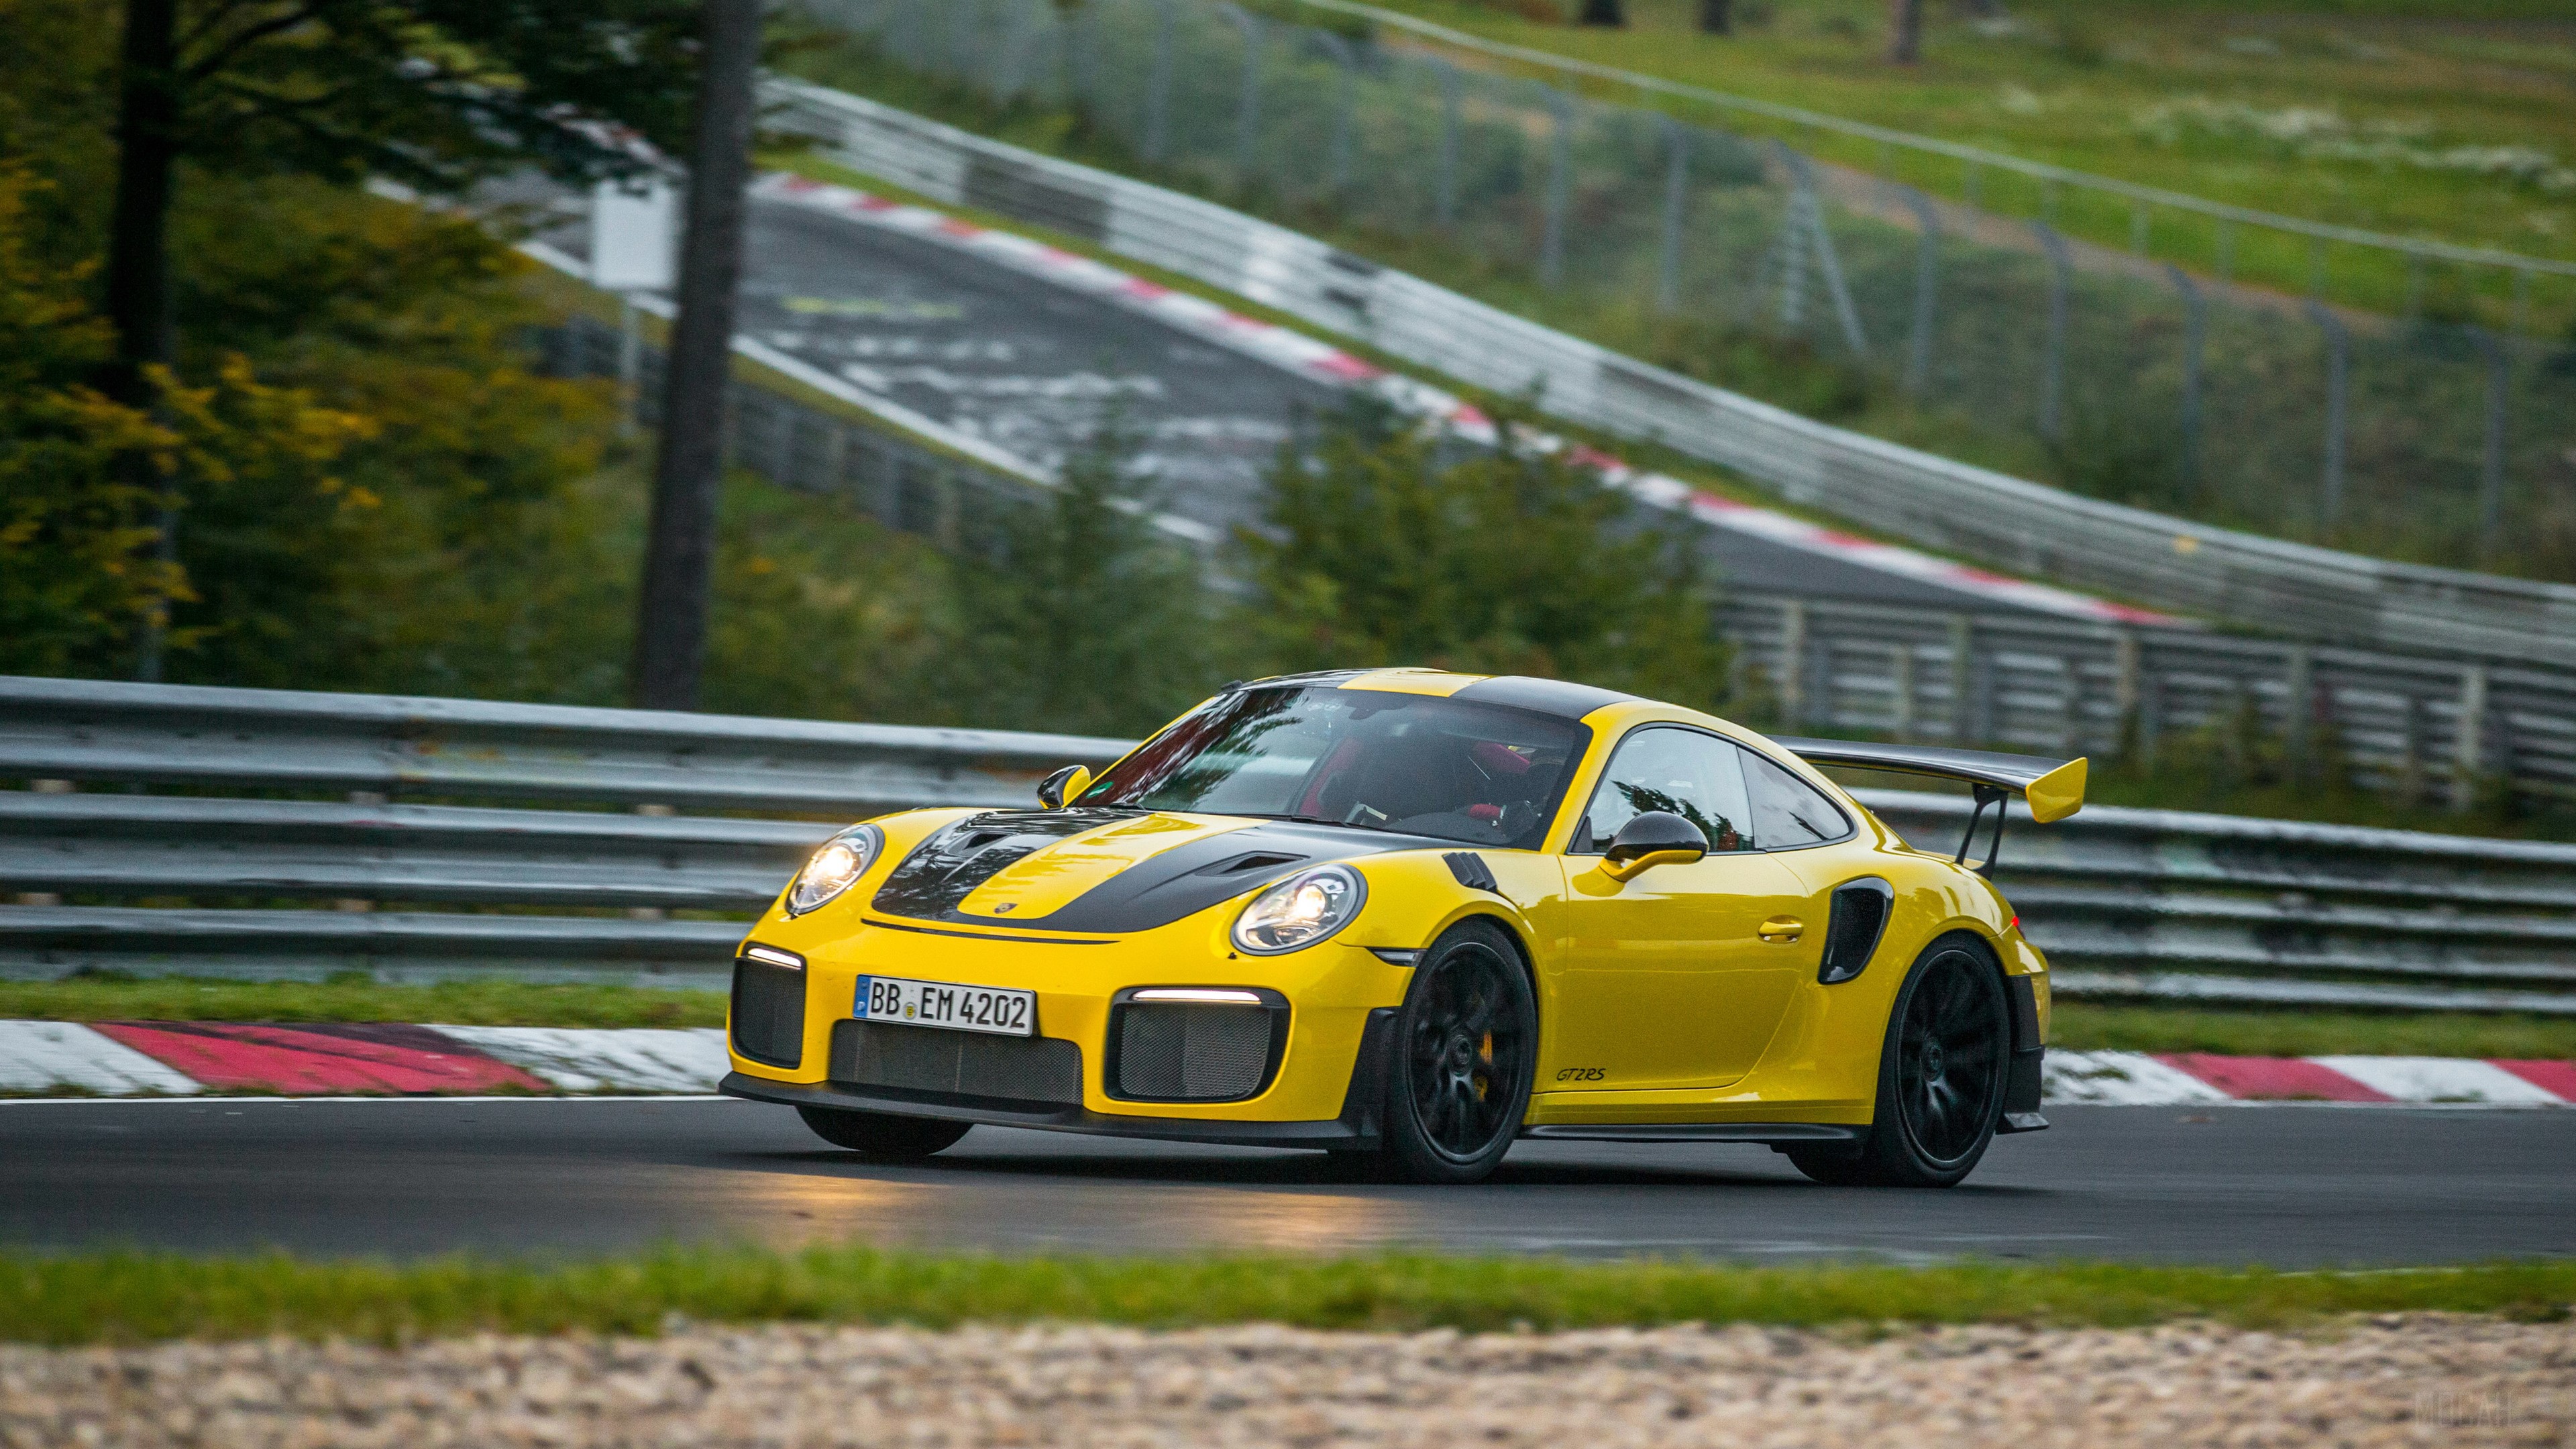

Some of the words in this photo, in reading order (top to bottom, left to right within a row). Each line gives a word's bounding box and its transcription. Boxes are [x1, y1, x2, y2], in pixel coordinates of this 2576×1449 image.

[871, 982, 900, 1015] BB
[920, 987, 954, 1021] EM
[959, 992, 1025, 1028] 4202
